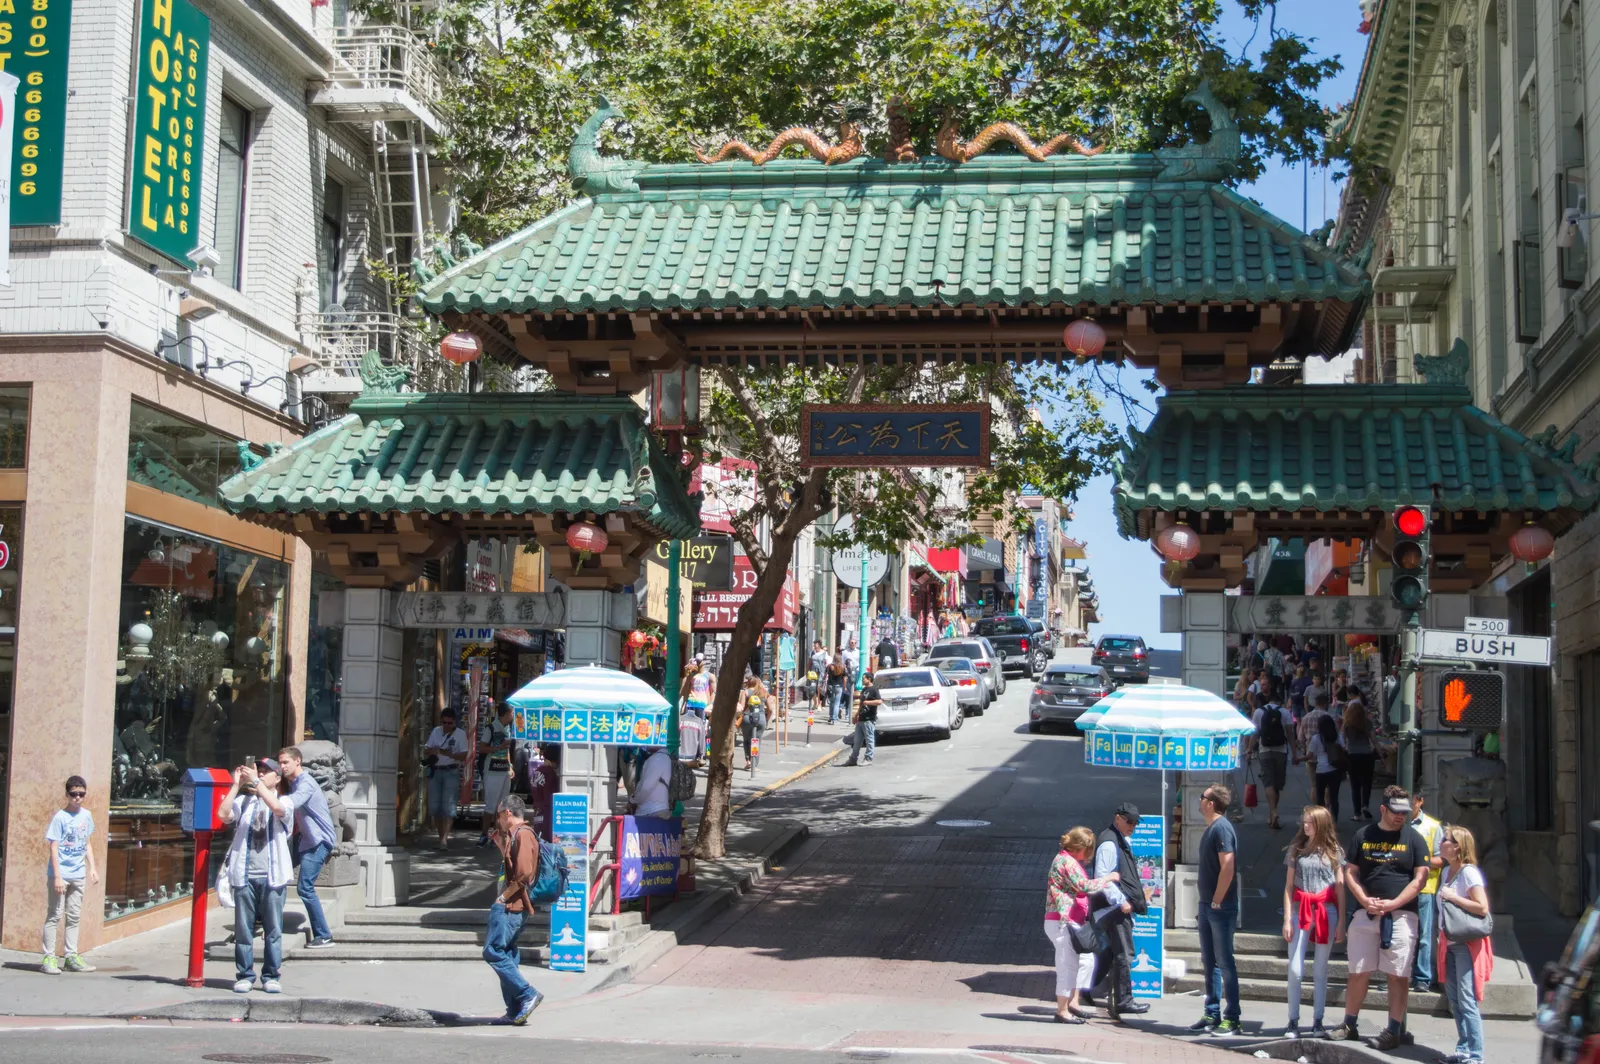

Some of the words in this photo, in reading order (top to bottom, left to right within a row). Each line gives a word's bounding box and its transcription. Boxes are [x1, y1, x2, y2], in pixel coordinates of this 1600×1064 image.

[142, 0, 172, 233] HOTEL
[164, 31, 184, 229] ASTORIA
[1038, 524, 1047, 557] CITY
[656, 540, 718, 564] Gllery
[971, 547, 986, 560] GRANT
[986, 552, 1001, 564] PLAZA
[719, 594, 752, 602] RESTAU
[455, 628, 492, 639] ATM
[1481, 621, 1504, 631] 500
[1455, 638, 1515, 656] BUSH
[1096, 738, 1111, 751] Fa
[1115, 739, 1131, 753] Lun
[1137, 741, 1157, 754] Da
[1165, 742, 1184, 756] Fa
[1194, 742, 1206, 755] is
[1212, 743, 1229, 756] Good
